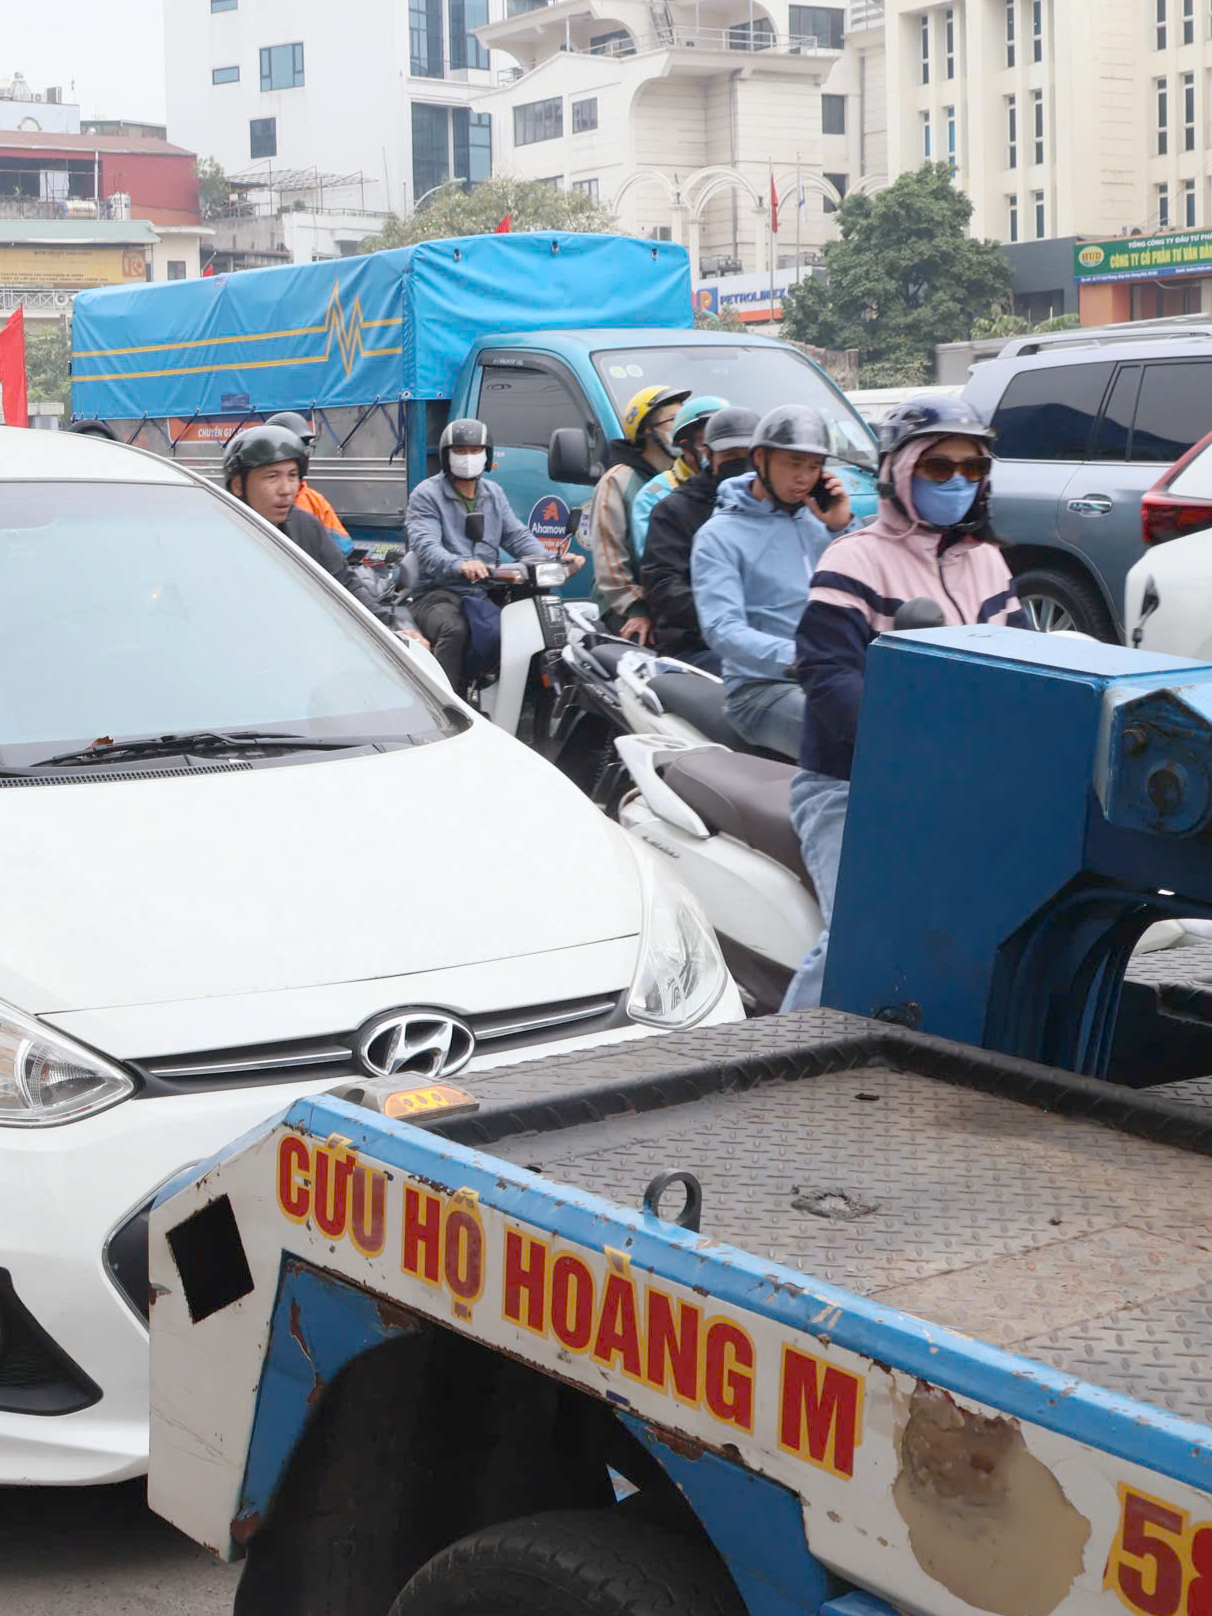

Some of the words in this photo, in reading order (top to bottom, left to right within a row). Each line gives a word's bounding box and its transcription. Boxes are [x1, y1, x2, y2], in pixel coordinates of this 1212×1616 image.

[1128, 240, 1146, 249] TỔNG
[1147, 237, 1165, 247] CÔNG
[1166, 236, 1173, 244] TY
[1175, 234, 1189, 243] ĐẦU
[1190, 233, 1200, 242] TƯ
[1081, 251, 1102, 262] HUD
[1110, 252, 1129, 268] CÔNG
[1130, 252, 1139, 266] TY
[1140, 248, 1150, 265] CỔ
[1152, 246, 1171, 264] PHẦN
[1172, 247, 1183, 262] TƯ
[720, 288, 786, 306] PETROLIMEX
[197, 426, 223, 437] CHUYÊN
[276, 1133, 389, 1258] CỨU
[401, 1187, 487, 1325] HỘ
[502, 1224, 756, 1435] HOÀNG
